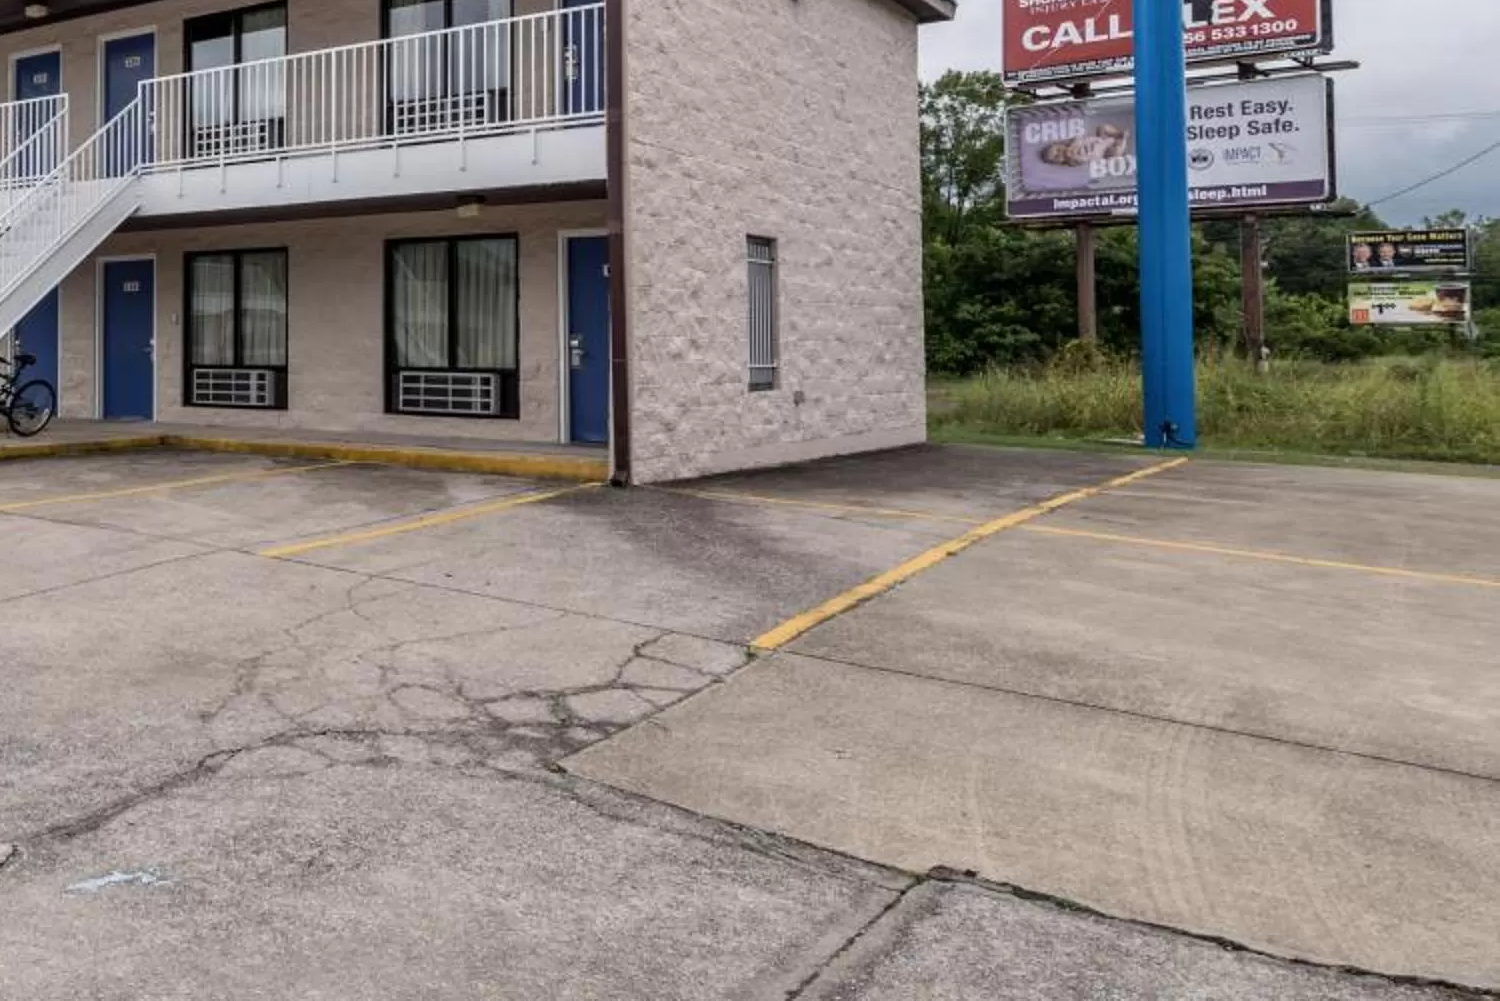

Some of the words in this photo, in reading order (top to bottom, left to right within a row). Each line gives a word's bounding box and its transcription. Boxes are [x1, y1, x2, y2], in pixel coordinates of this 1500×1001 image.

[1022, 14, 1134, 51] CALL
[1183, 30, 1206, 44] 56
[1211, 25, 1247, 40] 533
[1250, 18, 1299, 36] 1300
[1189, 103, 1234, 120] Rest
[1241, 99, 1294, 116] Easy.
[1025, 118, 1085, 144] CRIB
[1187, 124, 1241, 140] Sleep
[1247, 118, 1300, 136] Safe.
